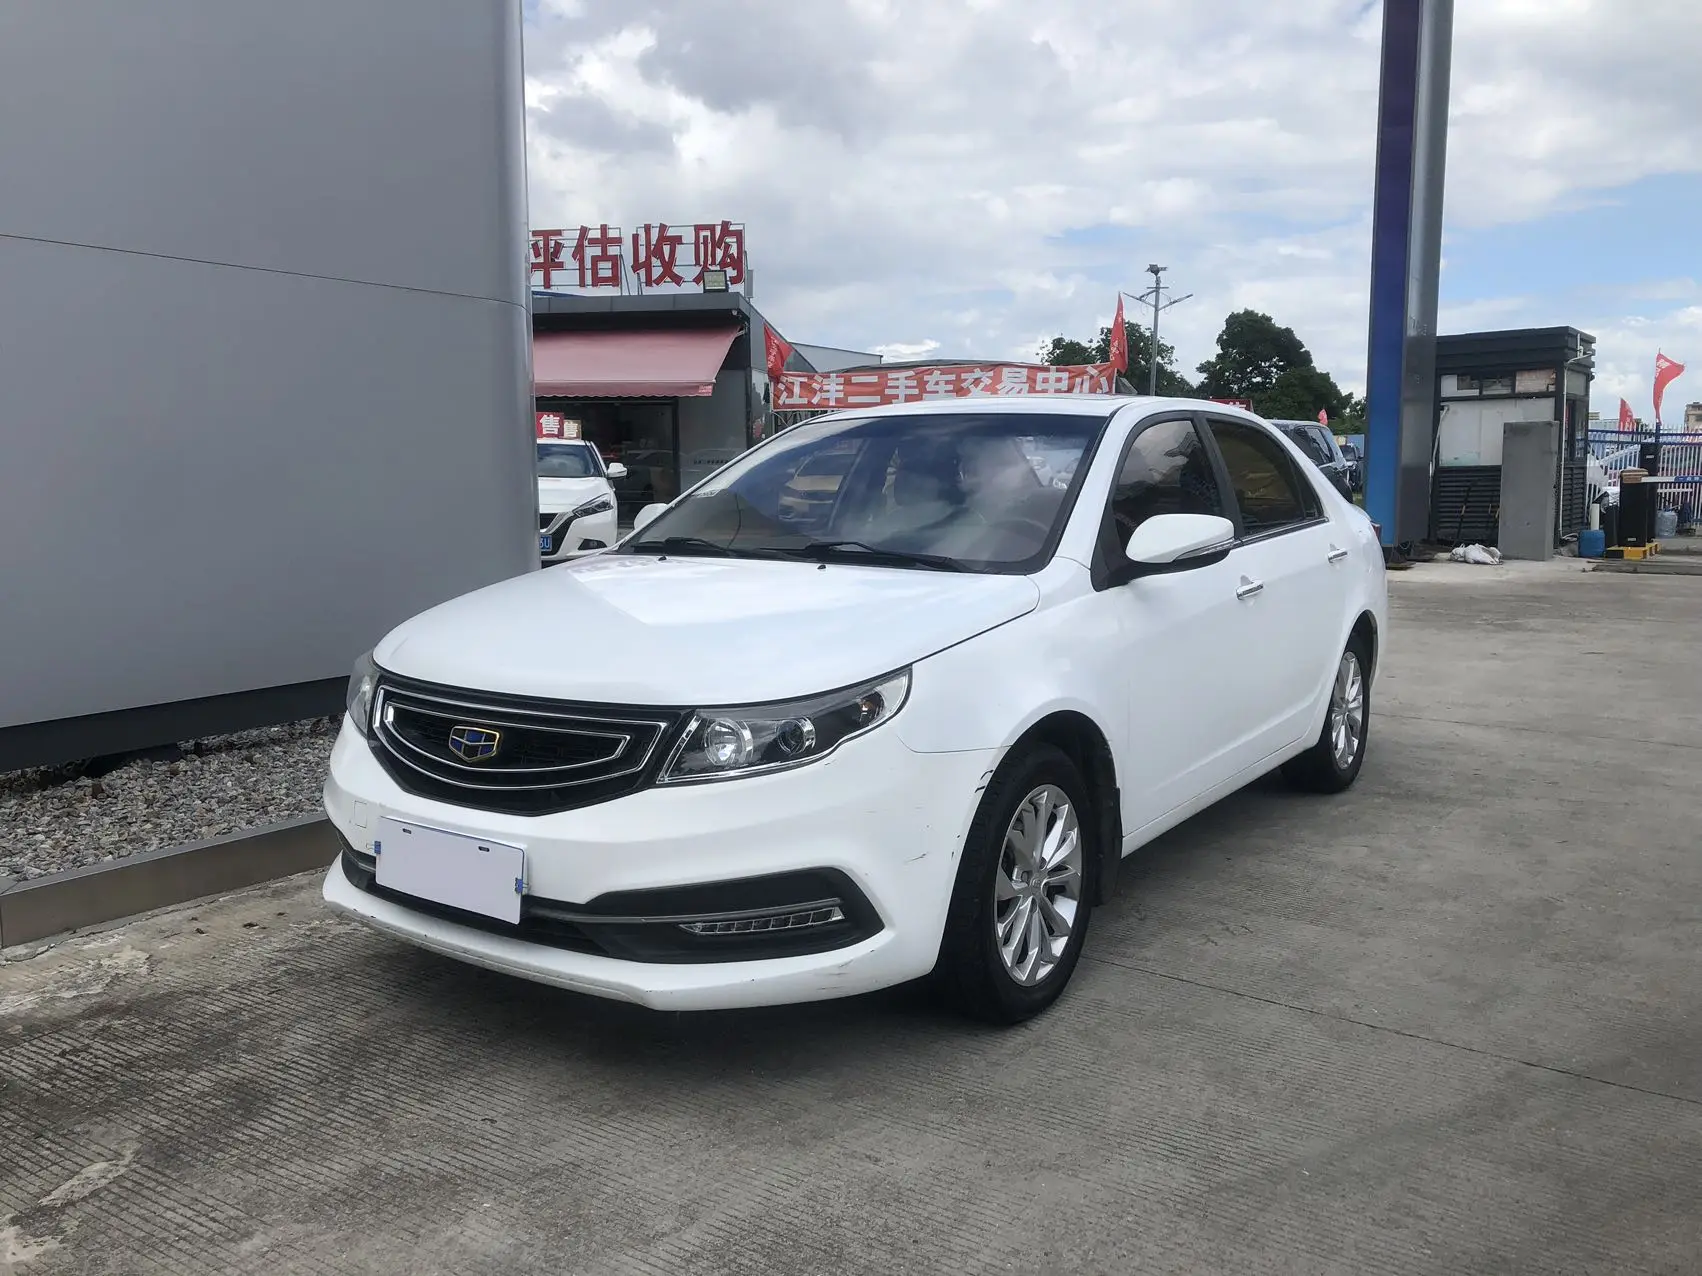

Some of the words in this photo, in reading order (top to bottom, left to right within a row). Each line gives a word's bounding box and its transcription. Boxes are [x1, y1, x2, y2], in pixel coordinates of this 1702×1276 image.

[777, 366, 1110, 406] 江沣二手车交易中心
[539, 414, 560, 435] 售
